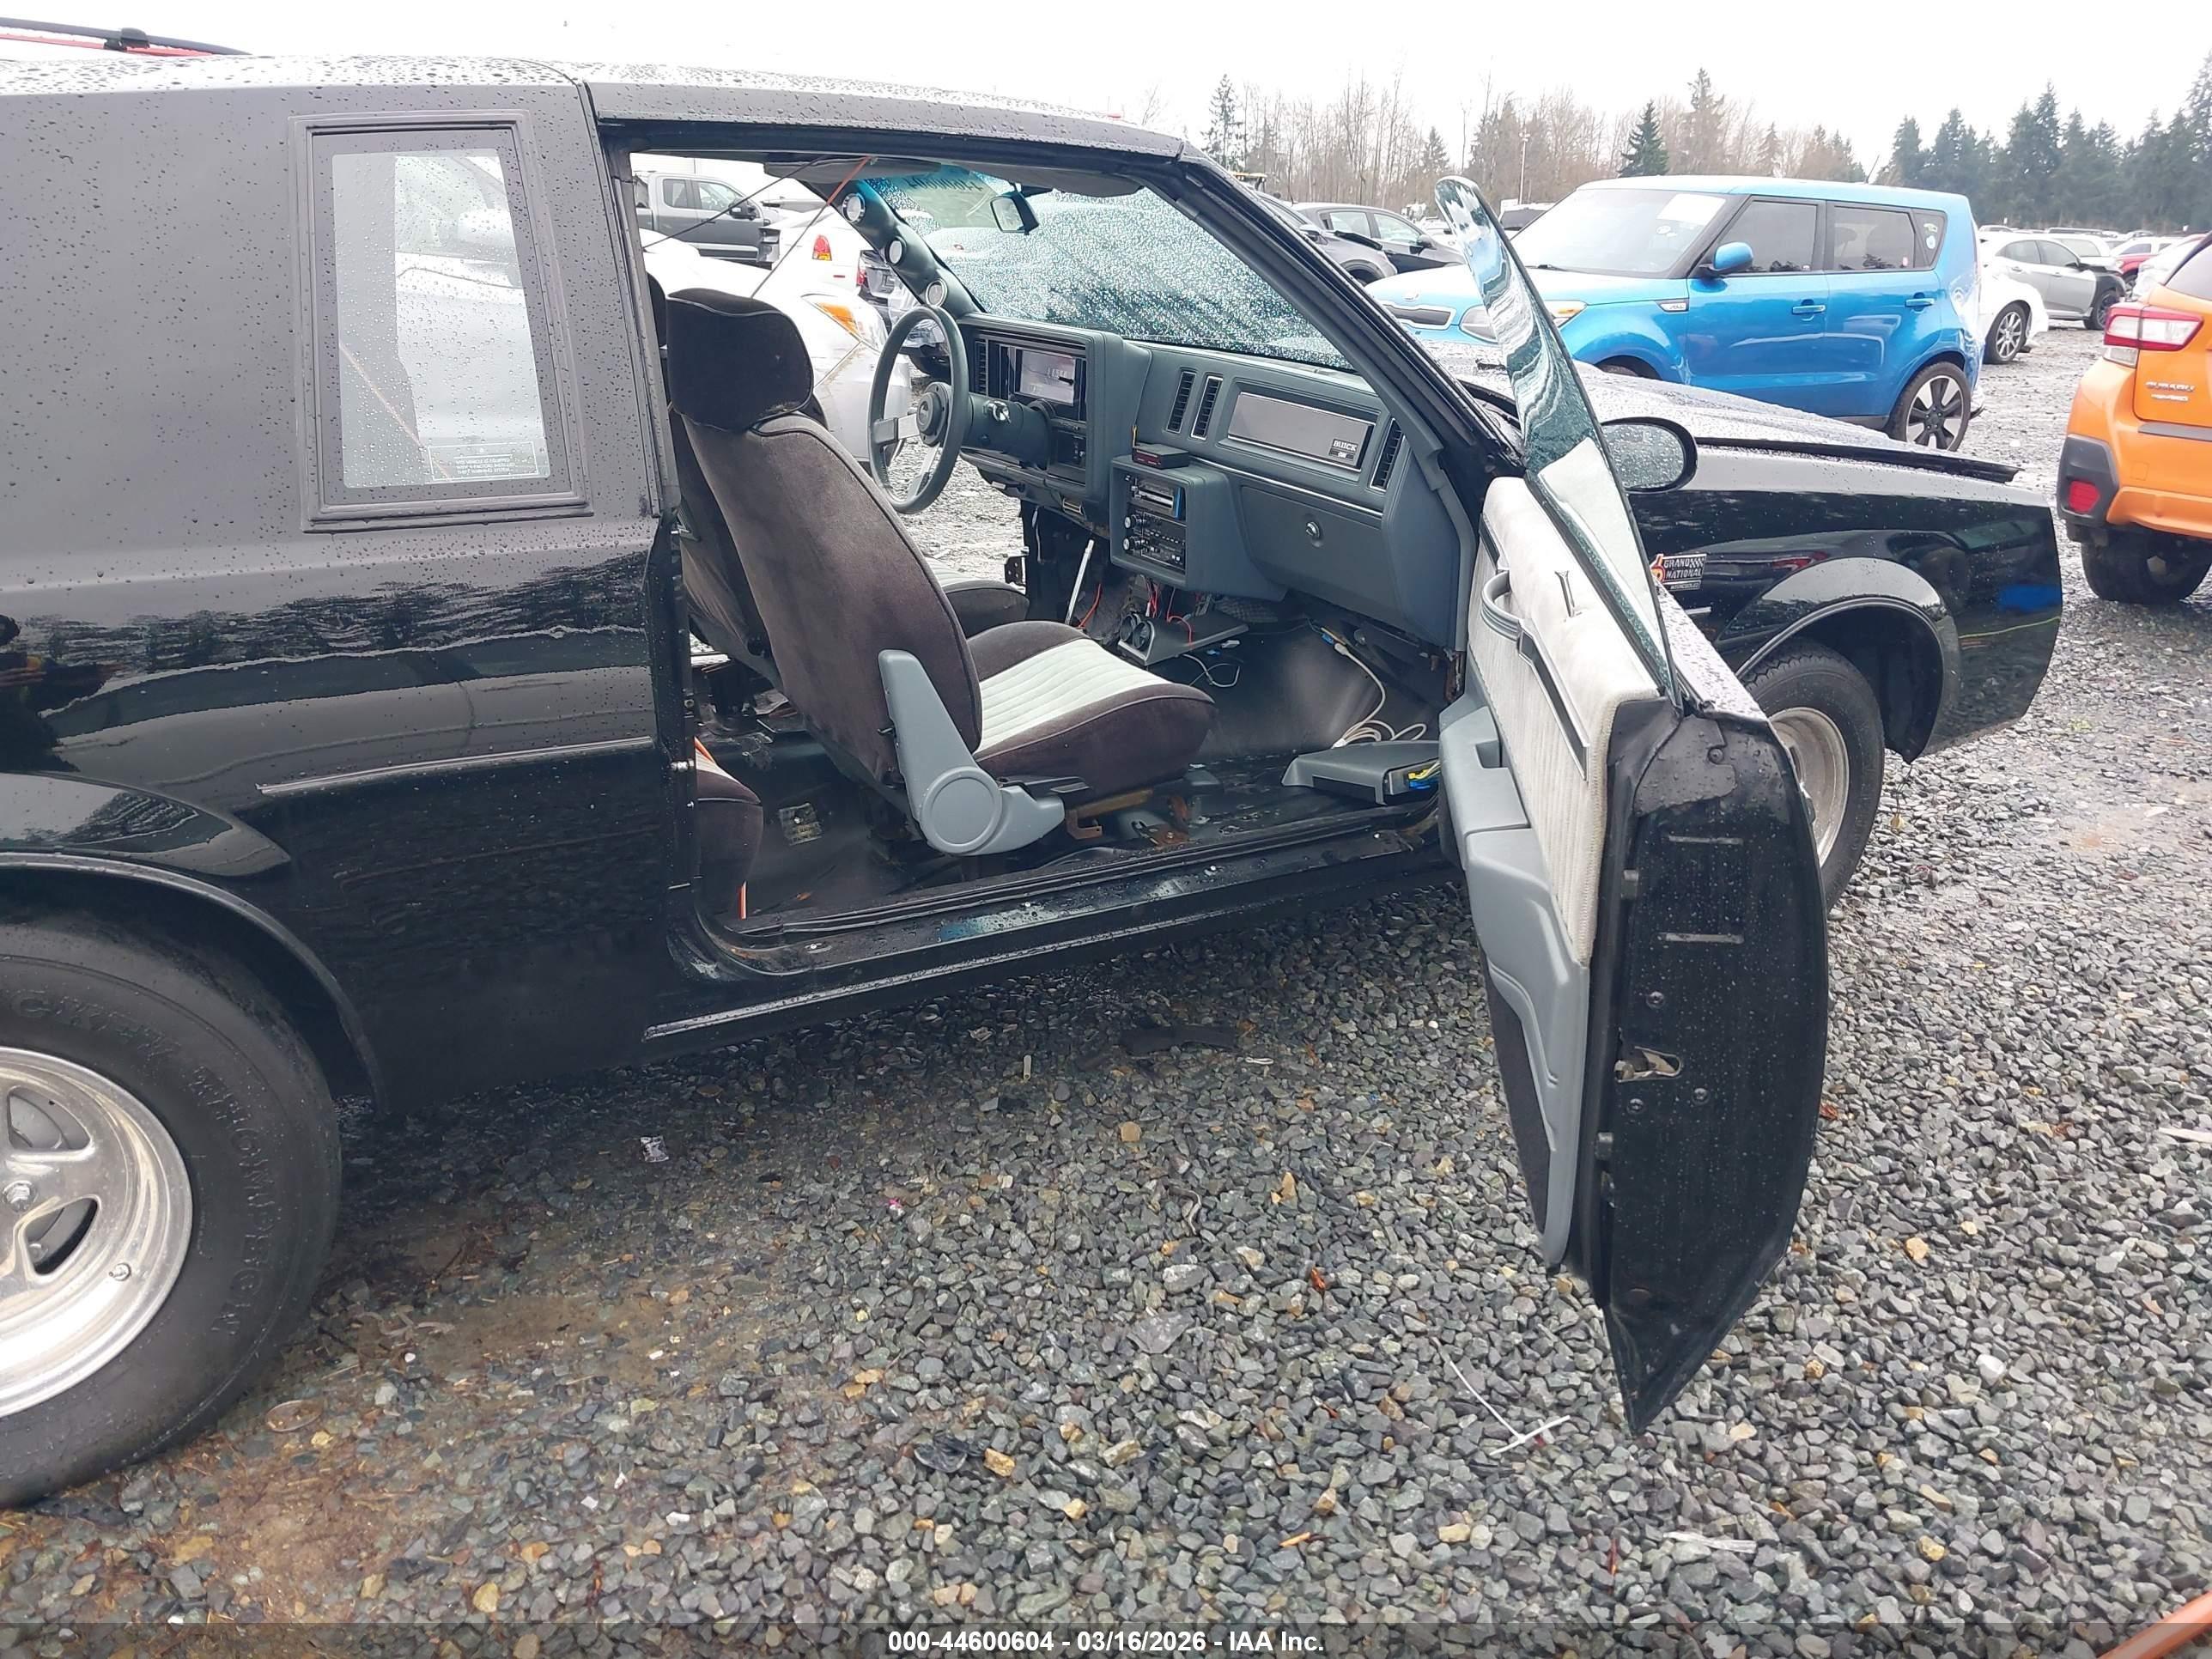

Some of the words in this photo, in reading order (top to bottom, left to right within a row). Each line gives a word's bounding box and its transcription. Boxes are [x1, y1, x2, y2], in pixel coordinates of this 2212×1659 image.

[1333, 440, 1358, 452] BUICK
[1663, 558, 1690, 568] GRAND
[1666, 568, 1701, 579] NATIONAL
